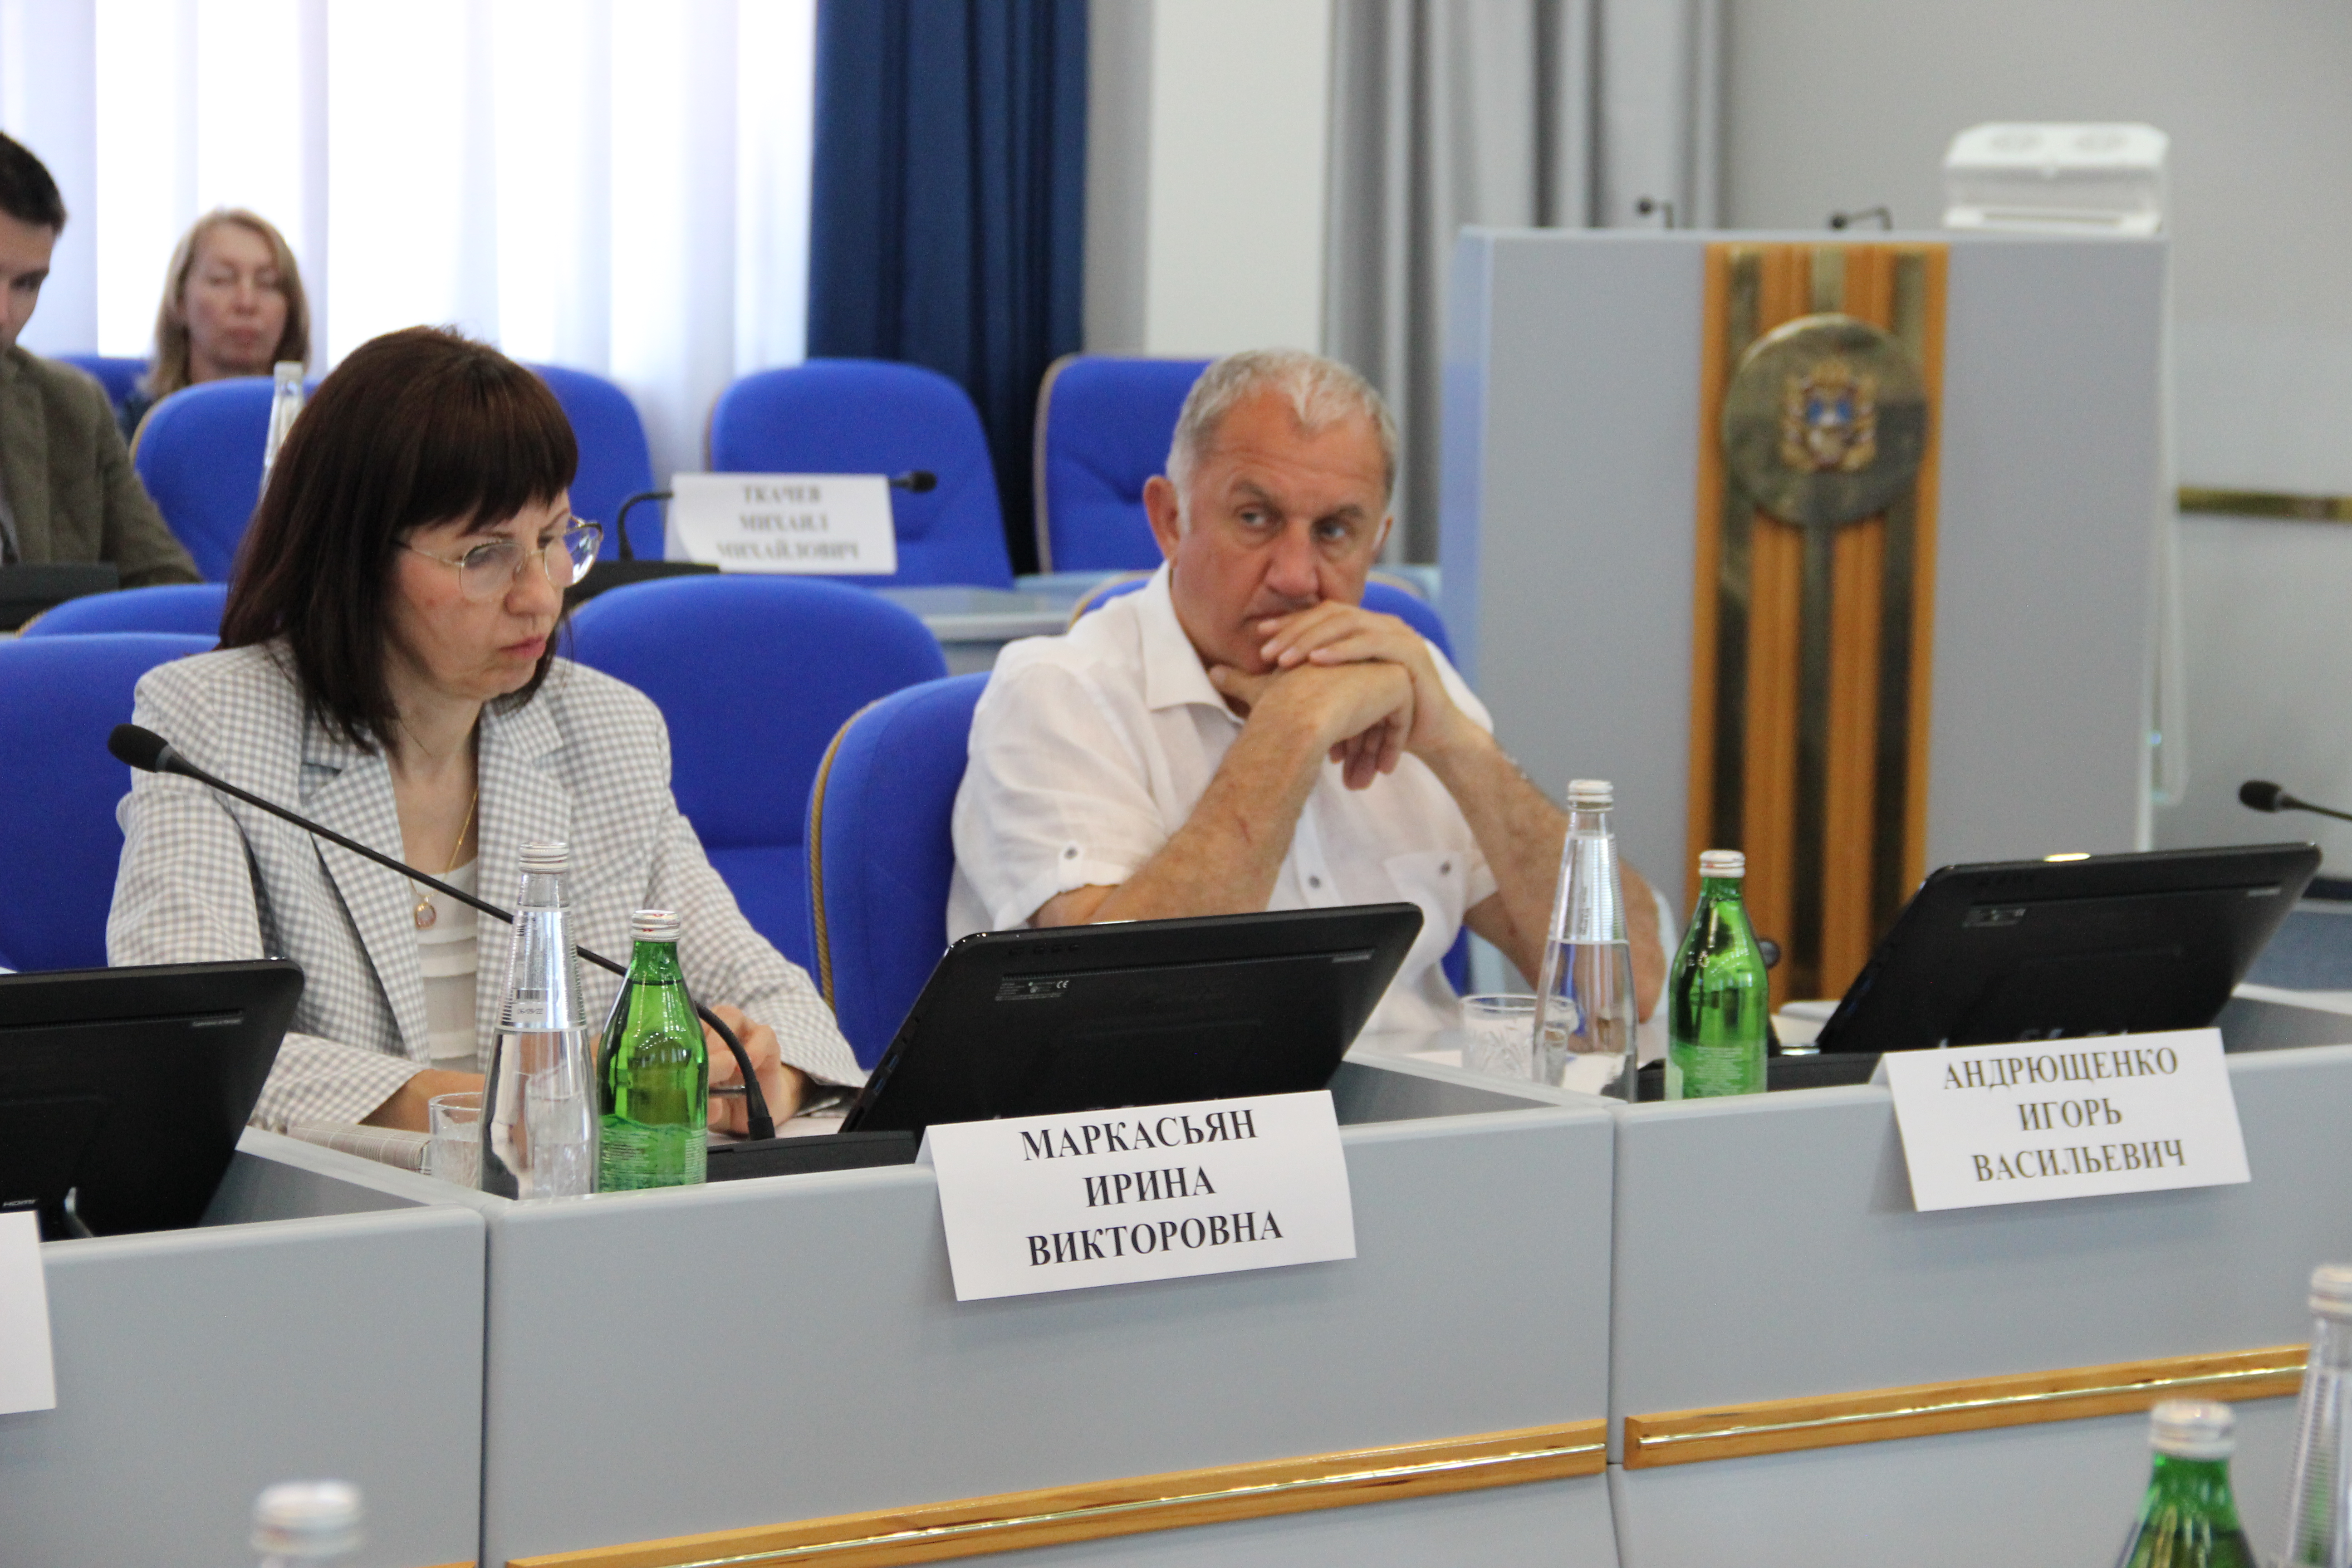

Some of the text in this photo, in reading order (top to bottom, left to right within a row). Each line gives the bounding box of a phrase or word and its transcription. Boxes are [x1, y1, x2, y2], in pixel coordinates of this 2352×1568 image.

[743, 485, 821, 504] ТКАЧЕВ
[740, 513, 829, 533] МИХАИЛ
[716, 540, 859, 560] МИХАЙЛОВИЧ
[1944, 1048, 2178, 1090] АНДРЮЩЕНКО
[1019, 1110, 1258, 1160] МАРКАСЬЯН
[2017, 1098, 2122, 1131] ИГОРЬ
[1971, 1139, 2187, 1181] ВАСИЛЬЕВИЧ
[1083, 1166, 1216, 1207] ИРИНА
[1026, 1210, 1283, 1266] ВИКТОРОВНА
